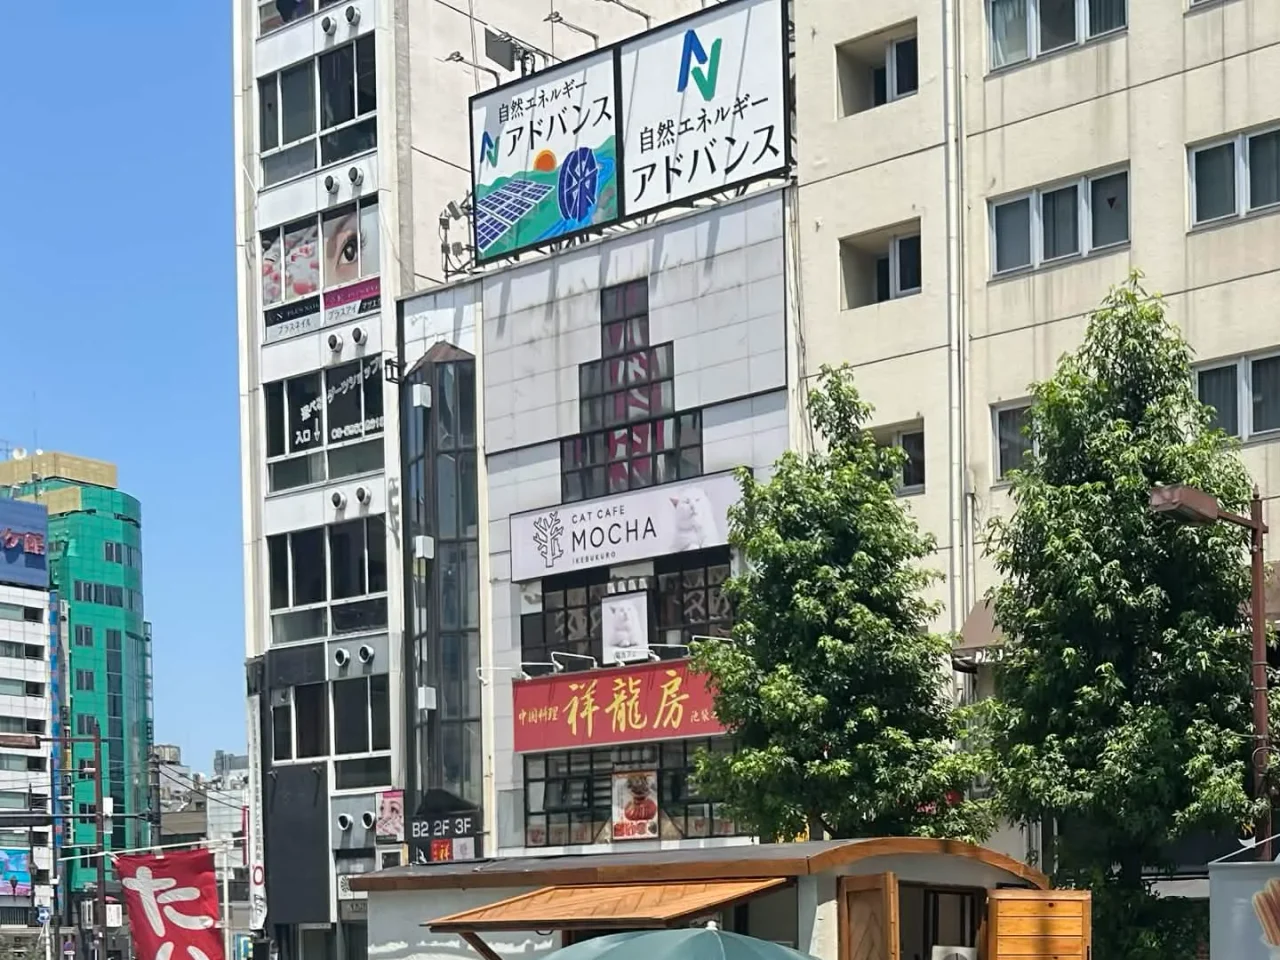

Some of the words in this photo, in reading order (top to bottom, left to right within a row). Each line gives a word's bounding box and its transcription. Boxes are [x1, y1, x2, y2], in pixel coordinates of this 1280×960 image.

[499, 79, 587, 123] 自然エネルギー
[506, 96, 612, 156] アドバンス
[640, 93, 769, 154] 自然エネルギー
[632, 125, 780, 202] アドバンス
[295, 429, 310, 445] 入口
[571, 510, 593, 524] CAT
[596, 505, 625, 520] CAFE
[572, 515, 657, 552] MOCHA
[572, 551, 616, 565] IKEBUKURO
[563, 669, 690, 739] 祥龍房
[412, 821, 429, 837] B2
[434, 820, 449, 836] 2F
[455, 818, 472, 834] 3F
